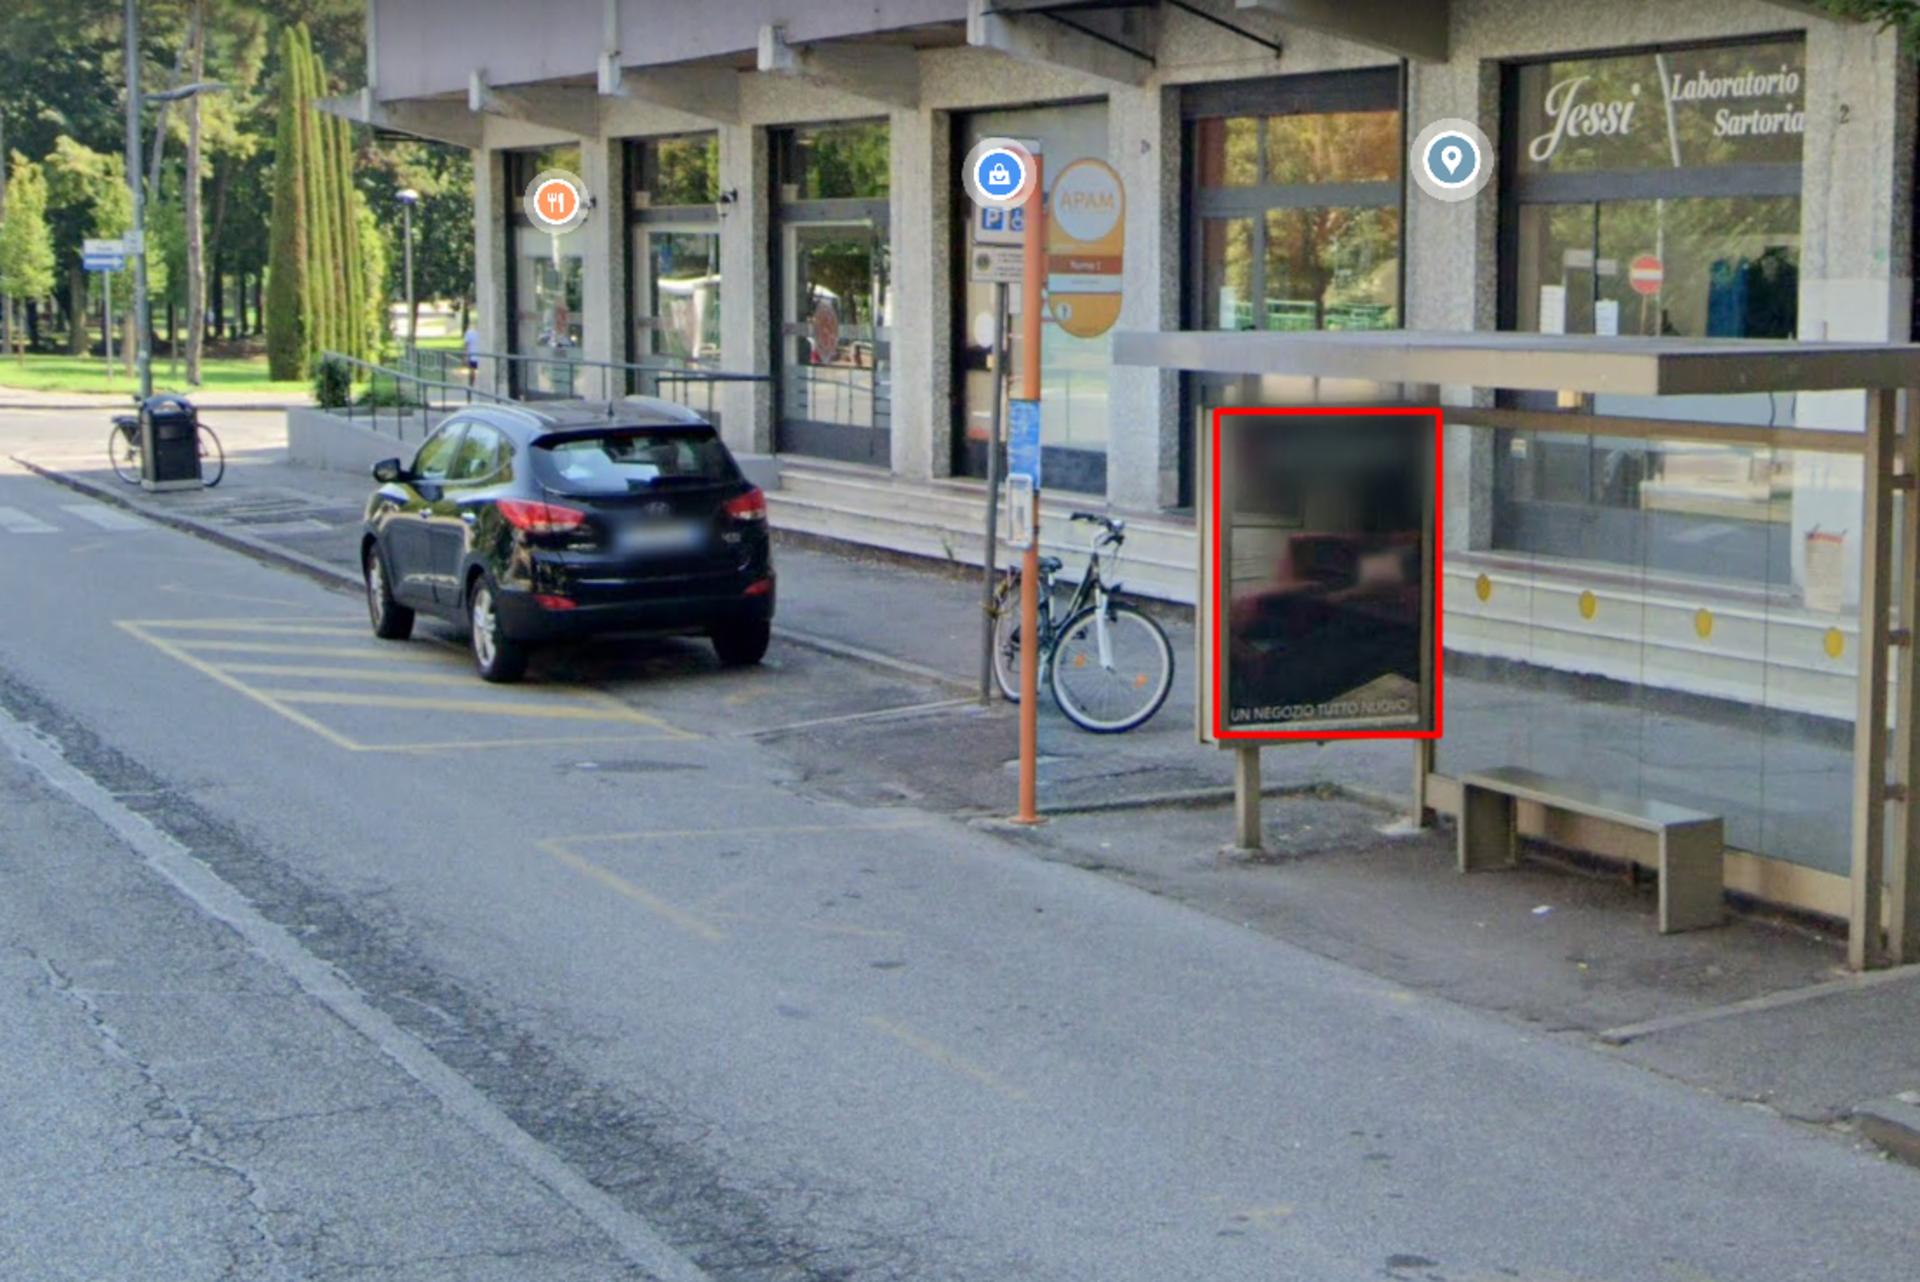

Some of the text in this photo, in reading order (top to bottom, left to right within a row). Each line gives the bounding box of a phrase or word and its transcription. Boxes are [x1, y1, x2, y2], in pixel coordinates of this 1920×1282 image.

[1670, 64, 1800, 102] Laboratorio
[1527, 75, 1641, 162] Jessi
[1713, 102, 1805, 138] Sartoria
[1060, 191, 1115, 210] APAM
[1230, 698, 1409, 721] UN NEGOZIO TUTTO NUOVO
